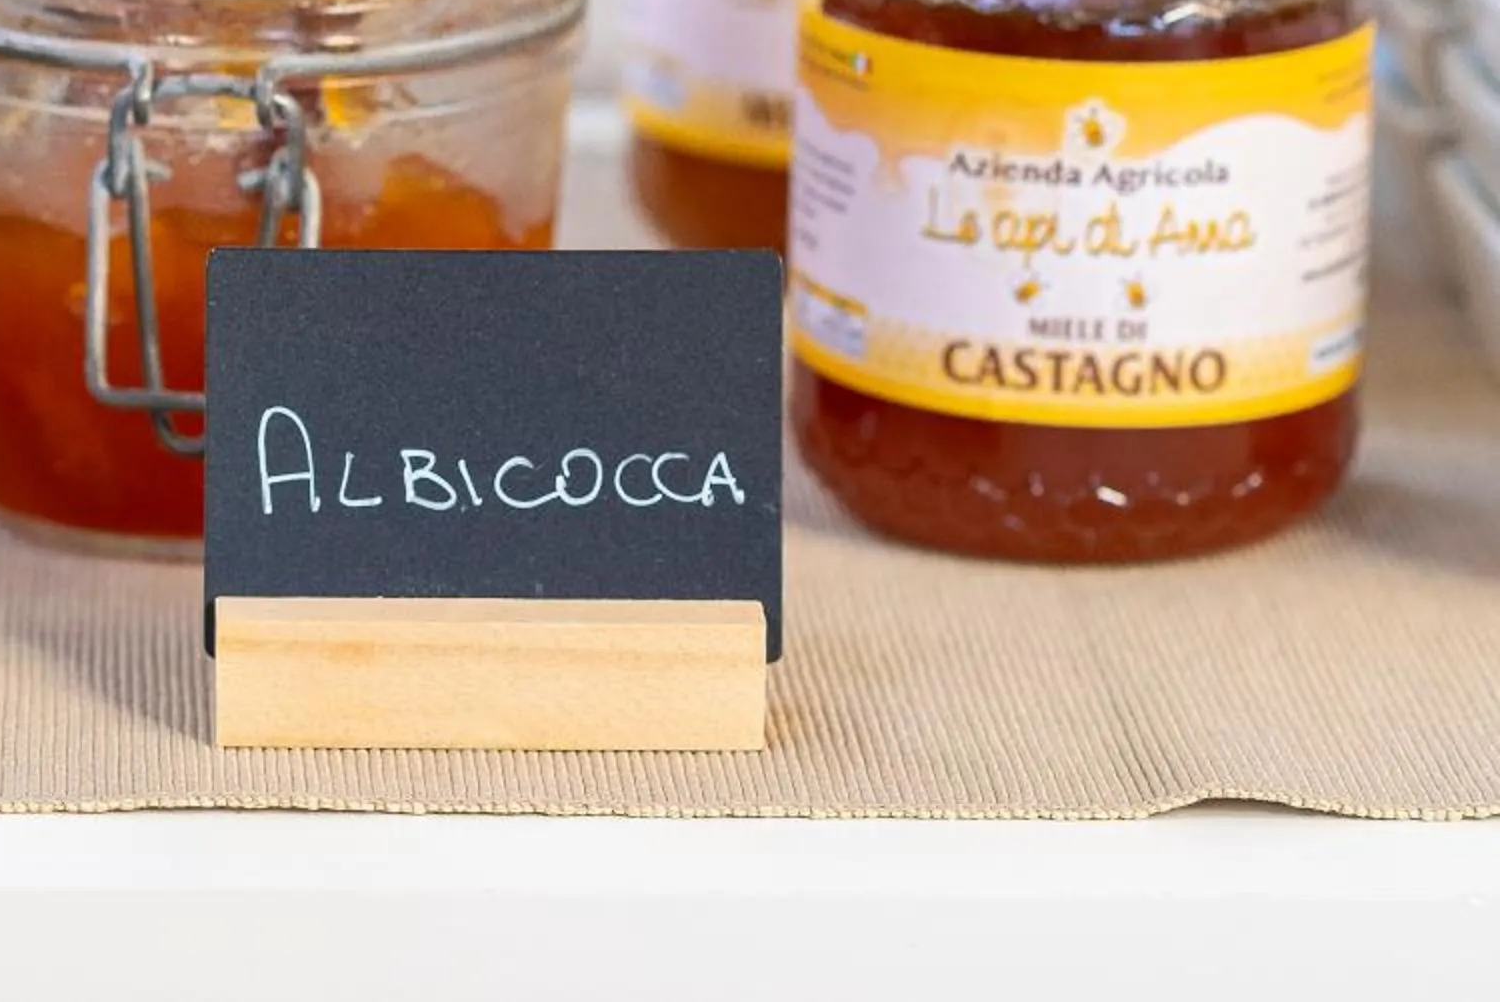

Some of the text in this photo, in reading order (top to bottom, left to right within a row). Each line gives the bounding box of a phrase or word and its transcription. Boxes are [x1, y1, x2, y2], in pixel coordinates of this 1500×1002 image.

[949, 151, 1230, 194] Azienda Agricola
[1148, 203, 1257, 257] Anna
[1028, 316, 1148, 342] MIELE DI
[941, 339, 1228, 395] CASTAGNO
[257, 406, 746, 515] ALBICOCCA
